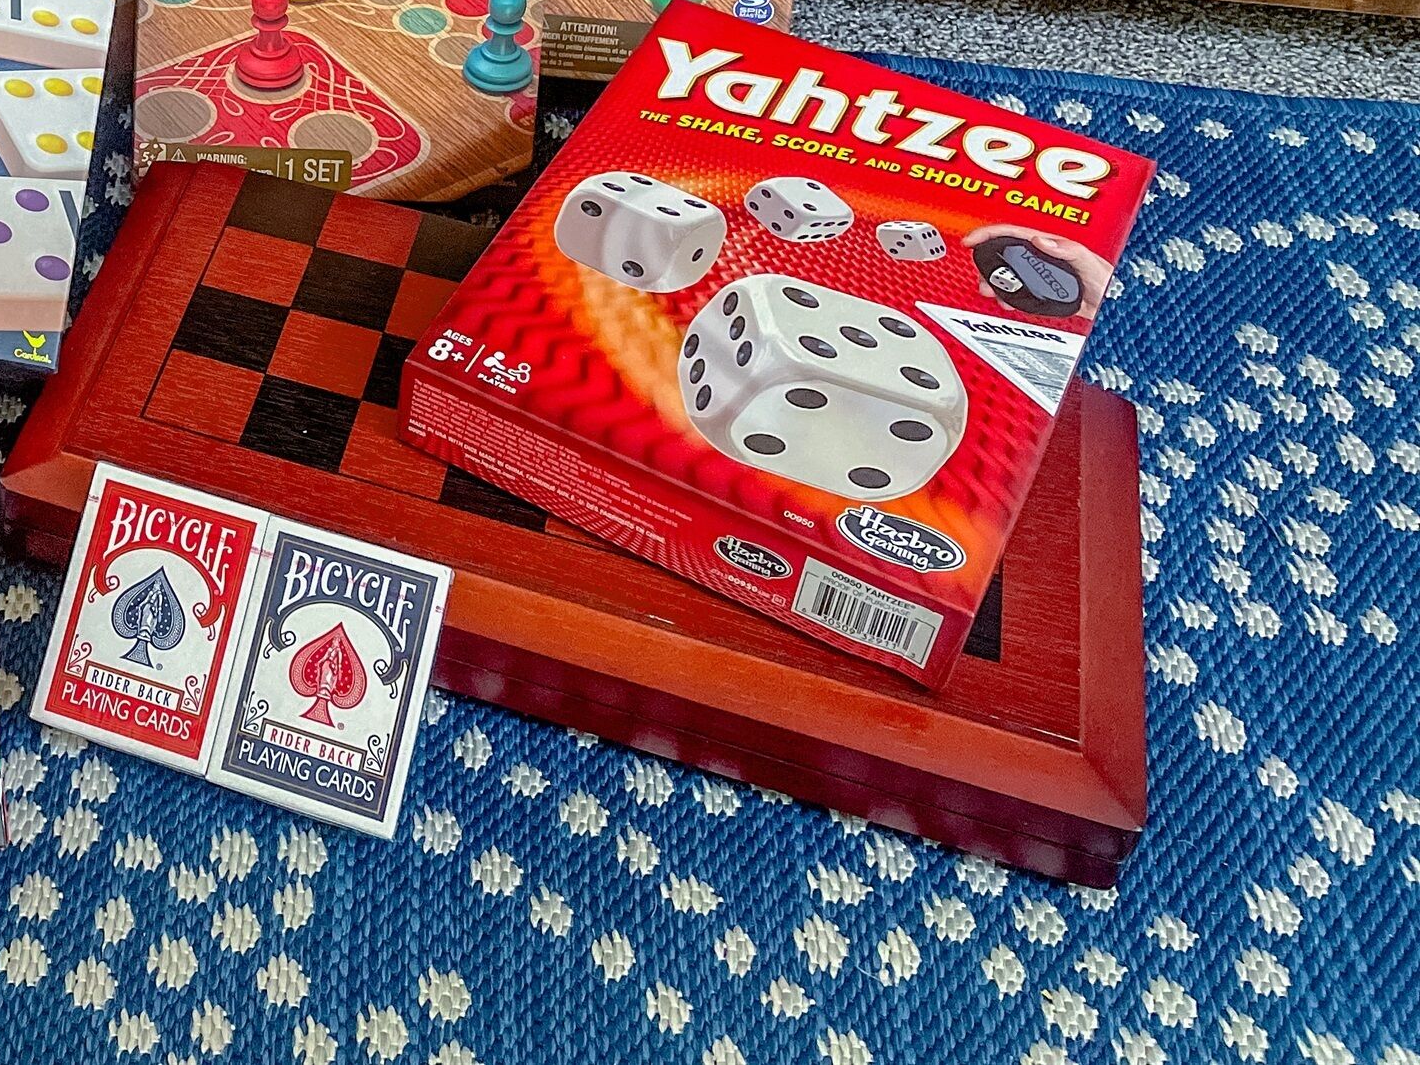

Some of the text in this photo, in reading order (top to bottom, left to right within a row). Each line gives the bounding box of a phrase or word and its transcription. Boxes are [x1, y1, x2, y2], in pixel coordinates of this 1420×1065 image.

[560, 21, 618, 35] ATTENTION!
[738, 7, 768, 15] SPIN
[657, 37, 1112, 200] Yahtzee
[197, 153, 248, 165] WARNING:
[284, 158, 344, 183] 1 SET
[640, 110, 1091, 226] THE SHAKE, SCORE, AND SHOUT GAME!
[1020, 250, 1070, 300] Yahtzee
[442, 329, 473, 347] AGES
[950, 317, 1067, 345] Yahtzee
[427, 338, 465, 363] 8+
[477, 373, 517, 395] PLAYERS
[783, 510, 815, 529] 00950
[848, 507, 955, 561] Hasbro
[104, 497, 238, 590] BICYCLE
[720, 537, 786, 573] Hasbro
[860, 531, 930, 570] Gaming
[728, 550, 771, 578] Gaming
[832, 571, 862, 589] 00950
[278, 549, 418, 649] BICYCLE
[728, 575, 758, 593] 00950
[822, 575, 851, 591] PROOF
[865, 595, 911, 616] PURCHASE
[91, 668, 171, 707] RIDER BACK
[62, 681, 193, 740] PLAYING CARDS
[269, 728, 355, 767] RIDER BACK
[239, 741, 377, 801] PLAYING CARDS
